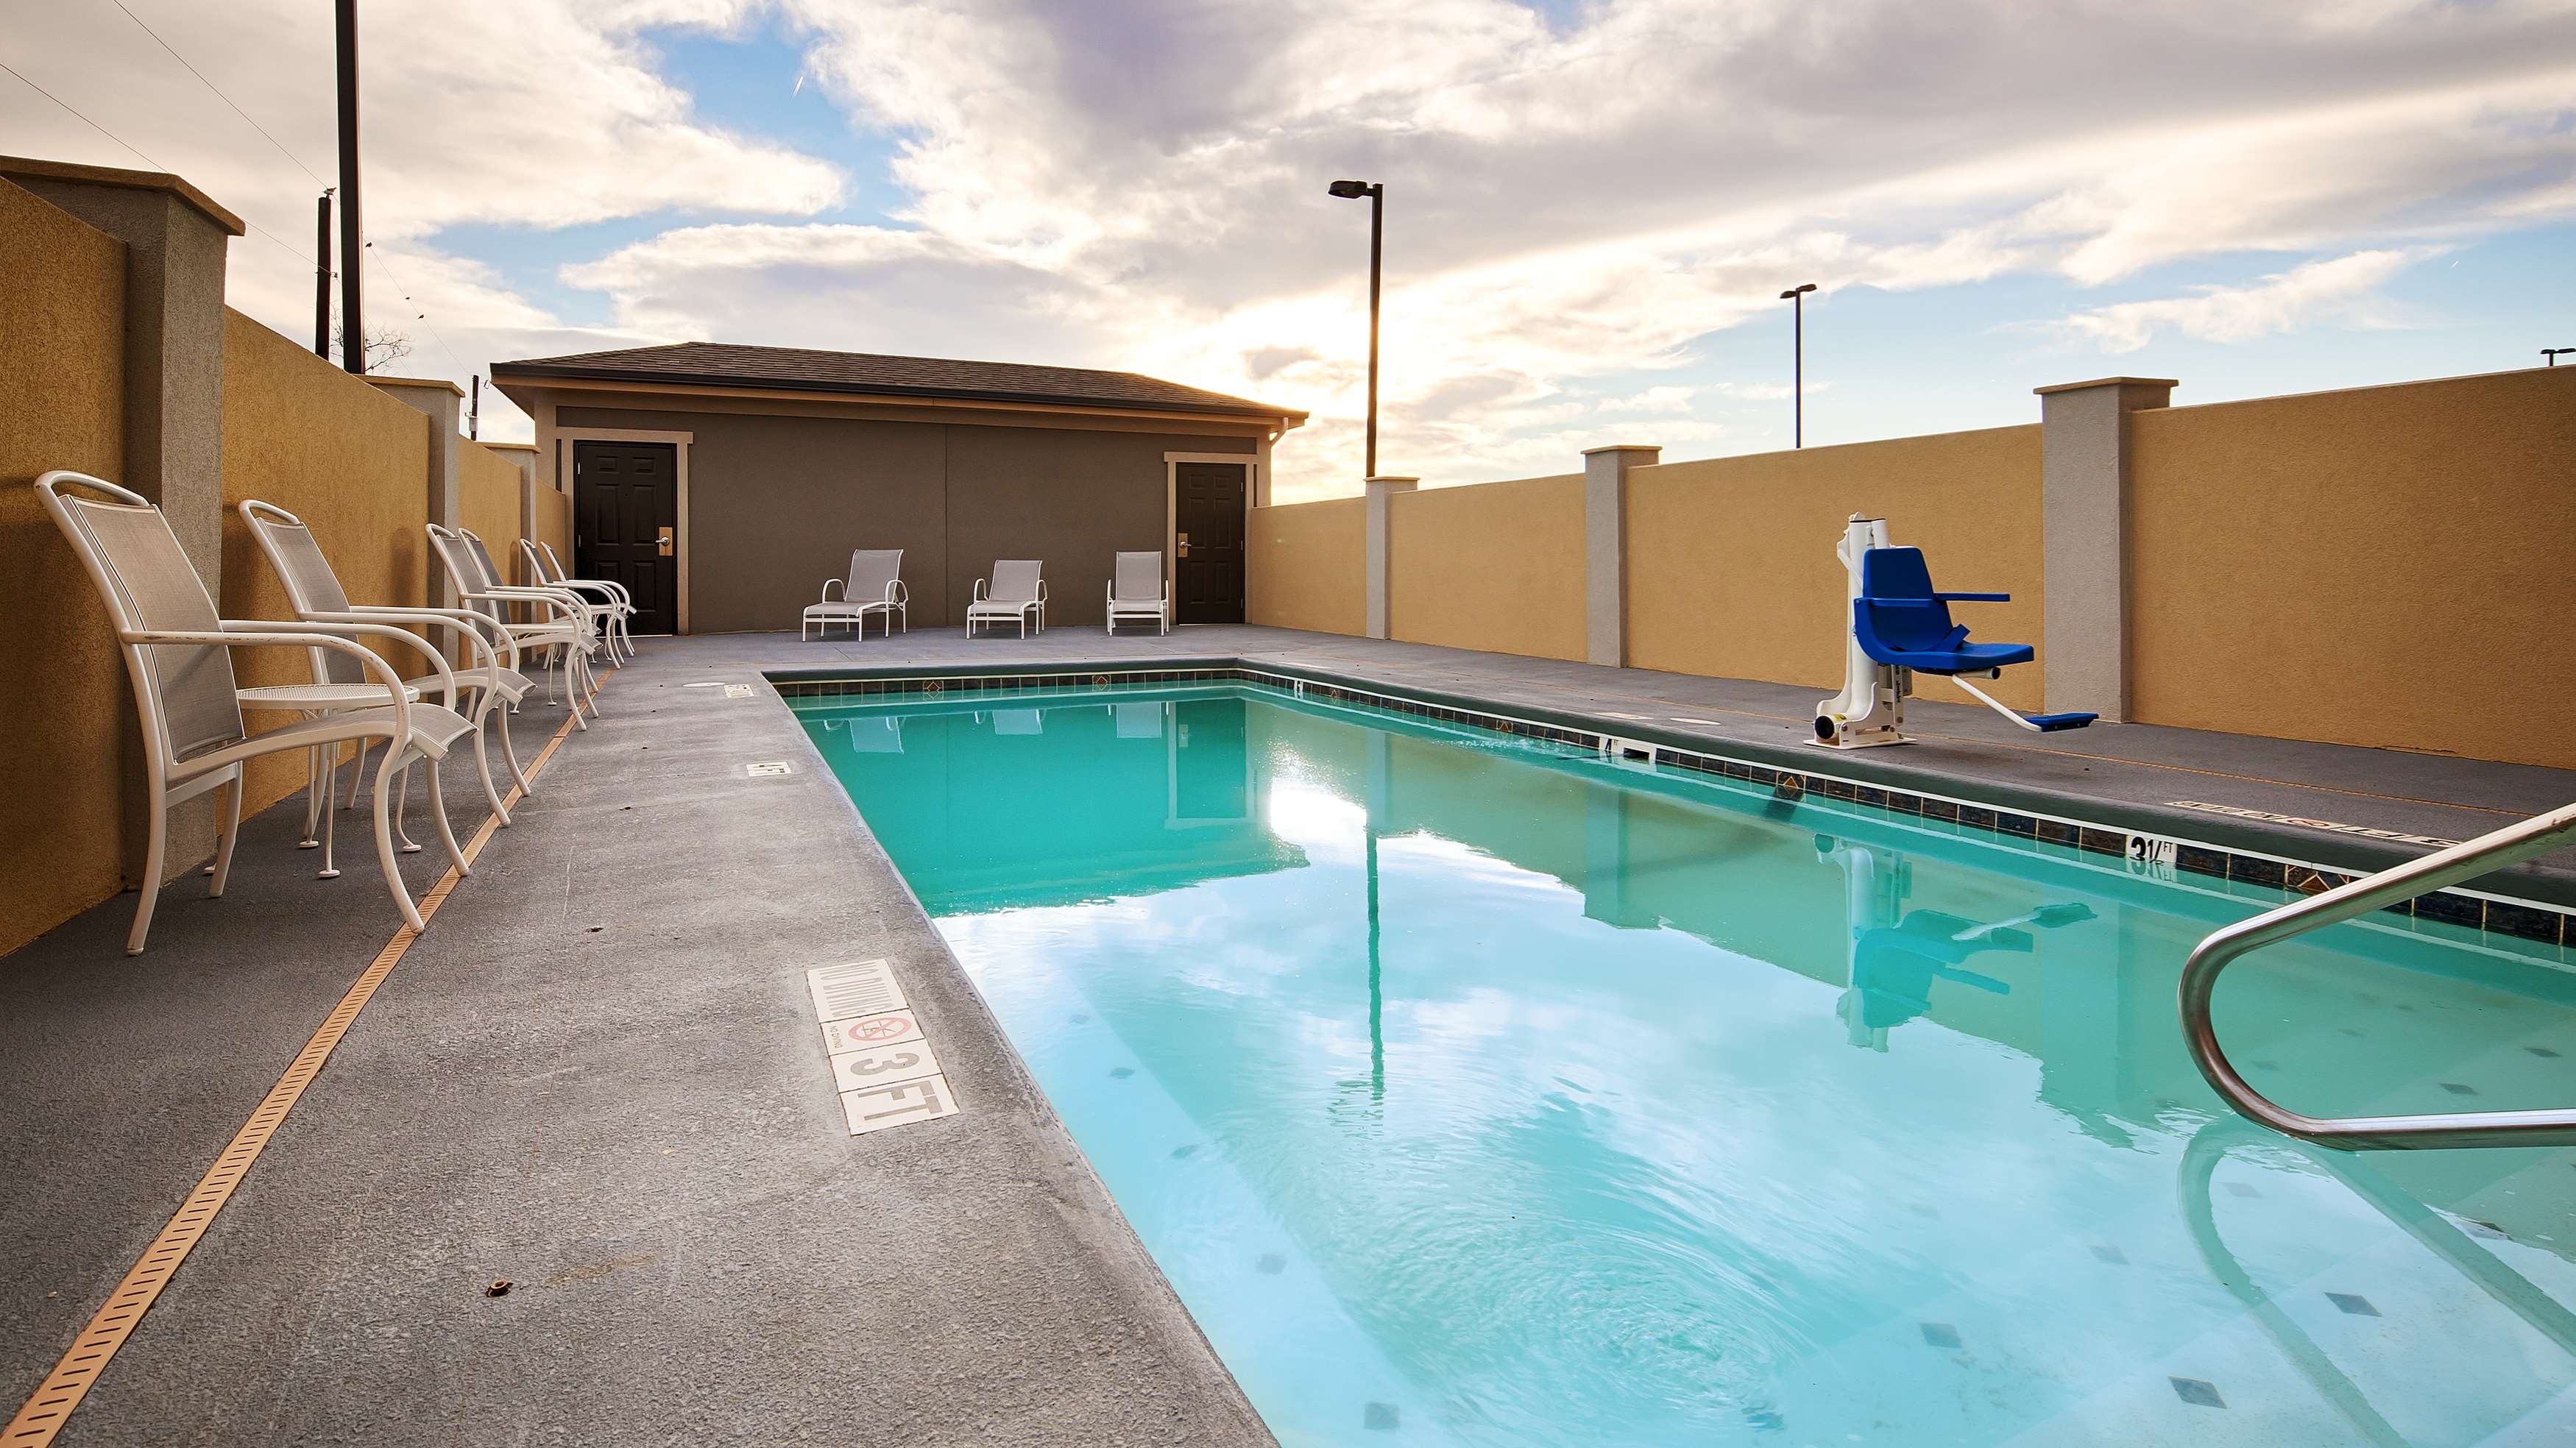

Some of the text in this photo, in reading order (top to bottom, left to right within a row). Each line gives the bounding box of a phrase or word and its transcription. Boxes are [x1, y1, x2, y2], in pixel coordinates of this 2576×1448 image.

[2164, 841, 2173, 853] FT
[2340, 828, 2406, 838] FT
[818, 962, 894, 1018] NO DIVING
[850, 1052, 944, 1121] 3 FT
